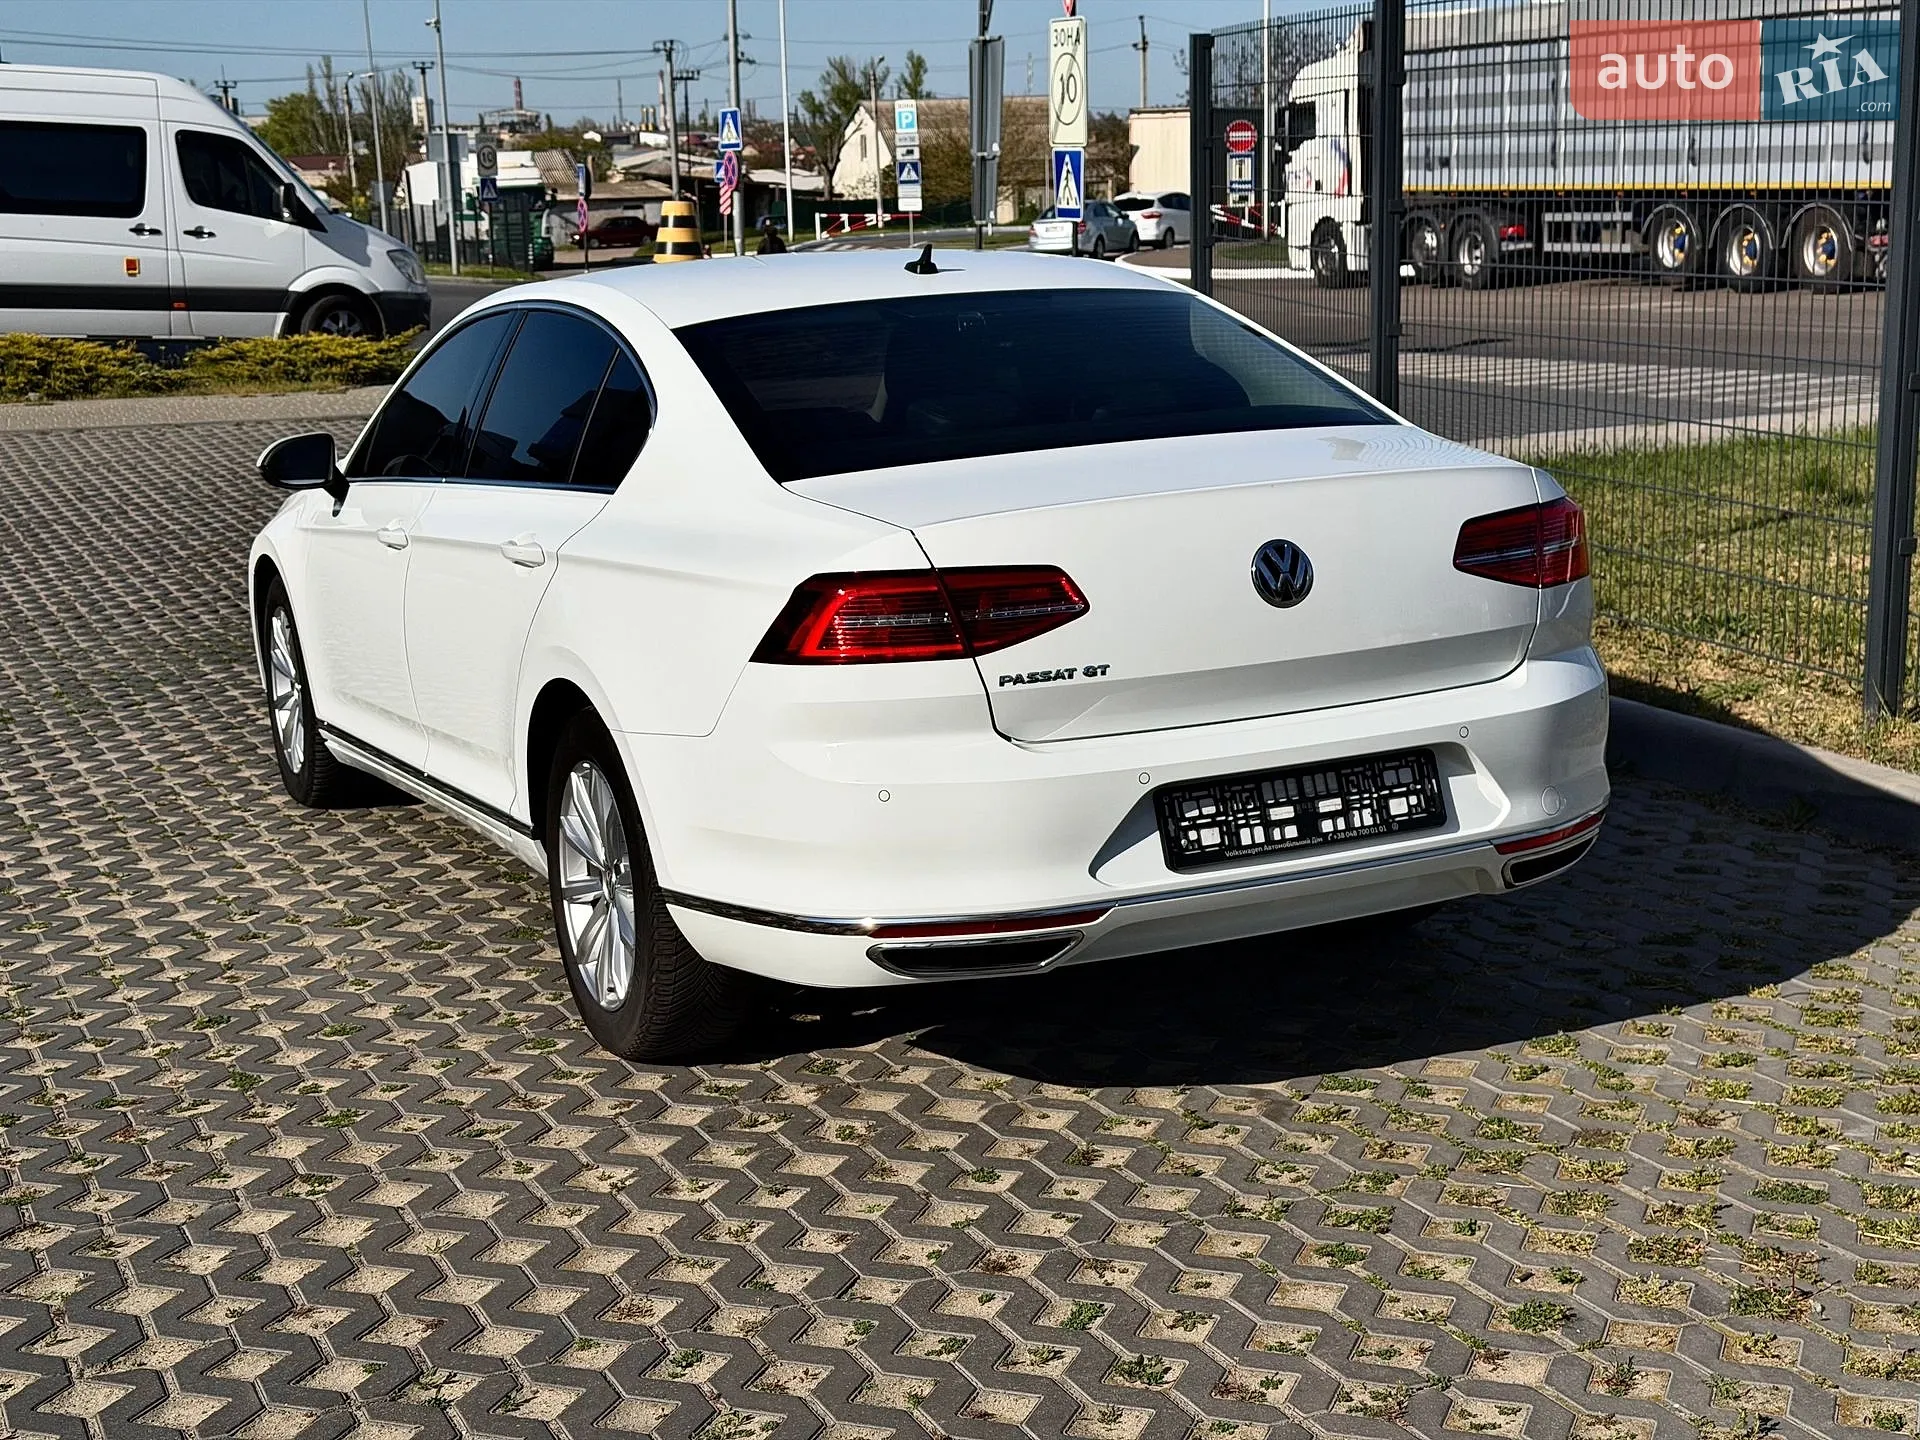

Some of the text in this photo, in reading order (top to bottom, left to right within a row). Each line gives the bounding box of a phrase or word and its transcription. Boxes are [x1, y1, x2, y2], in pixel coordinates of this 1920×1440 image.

[1054, 26, 1080, 47] ЗОНА
[1060, 73, 1078, 104] 10
[998, 664, 1111, 687] PASSAT GT
[1225, 845, 1263, 857] Volkswagen
[1359, 828, 1370, 836] 700
[1371, 826, 1379, 834] 01
